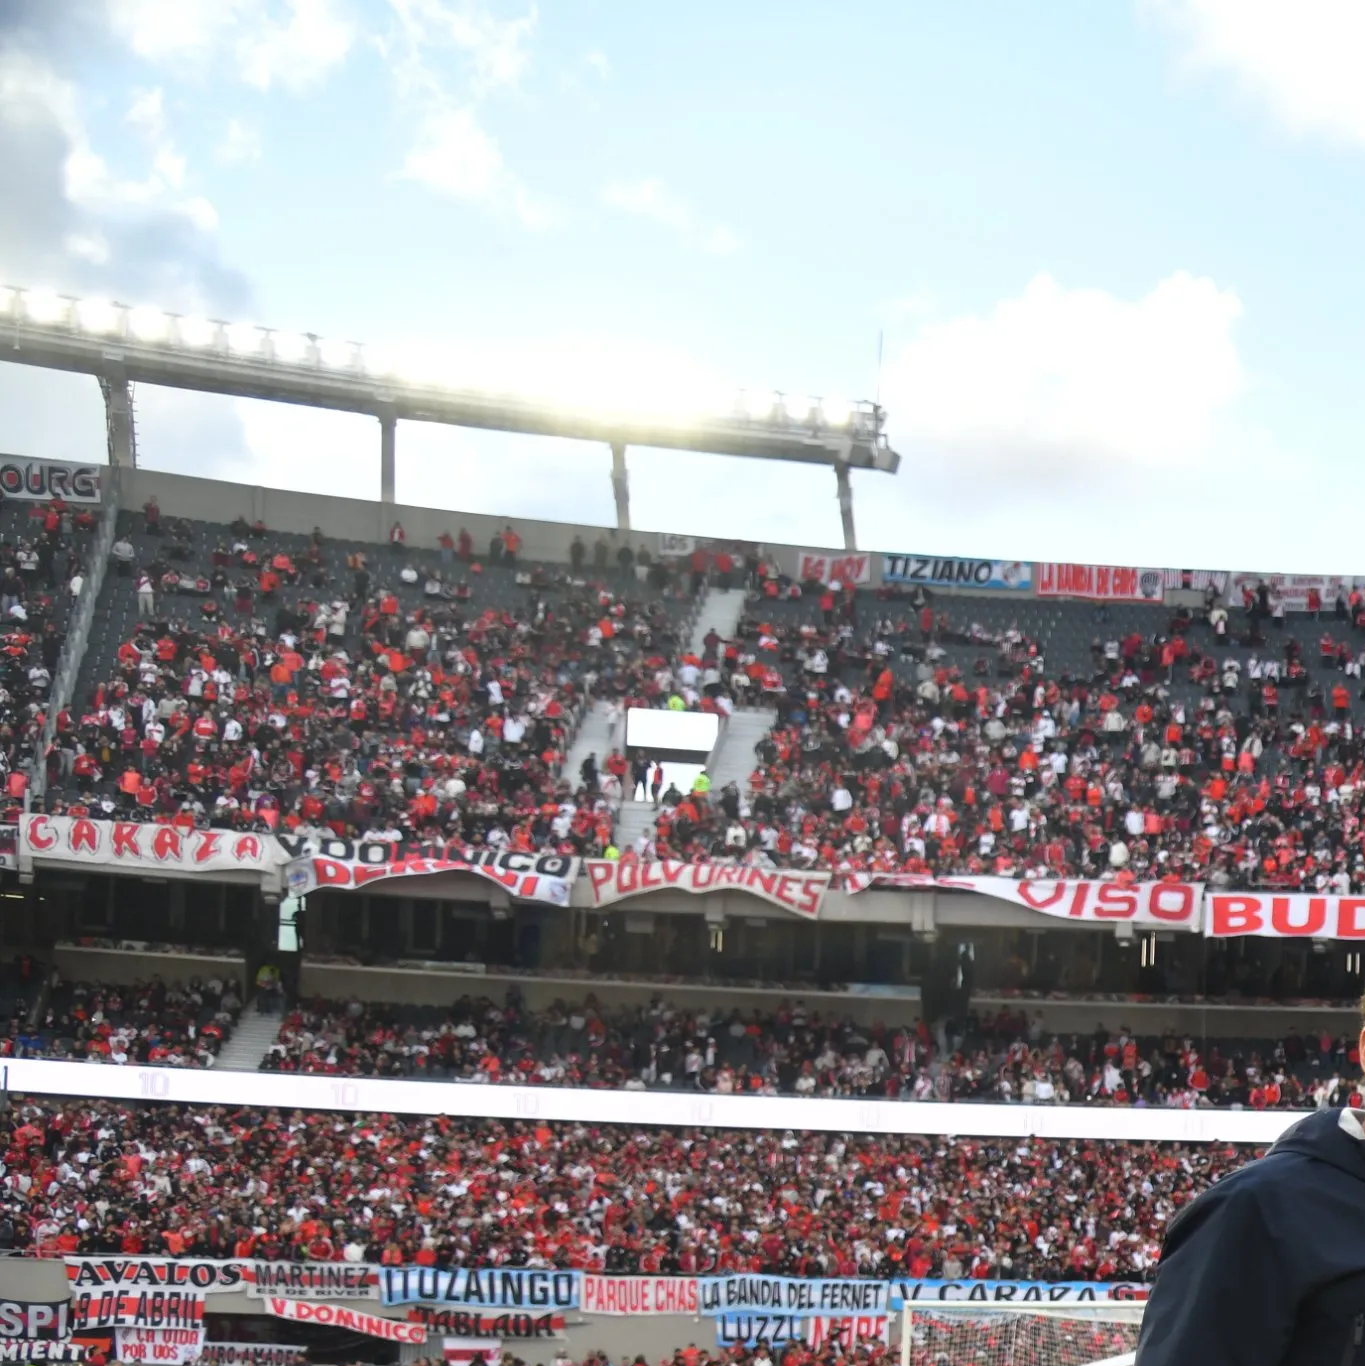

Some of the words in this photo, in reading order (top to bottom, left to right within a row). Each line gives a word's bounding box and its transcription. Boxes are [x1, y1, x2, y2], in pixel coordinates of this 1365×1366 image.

[887, 556, 994, 584] TIZIANO
[27, 816, 263, 863] CARAZA
[75, 1261, 243, 1287] AVALOS
[255, 1265, 370, 1287] MARTINEZ
[384, 1267, 573, 1306] ITUZAINGO
[98, 1290, 130, 1327] DE
[134, 1290, 203, 1329] ABRIL
[585, 1279, 650, 1312] PARQUE
[655, 1280, 697, 1312] CHAS
[702, 1284, 720, 1310] LA
[727, 1277, 782, 1309] BANDA
[789, 1281, 816, 1309] DEL
[821, 1284, 882, 1311] FERNET
[122, 1345, 148, 1364] POR
